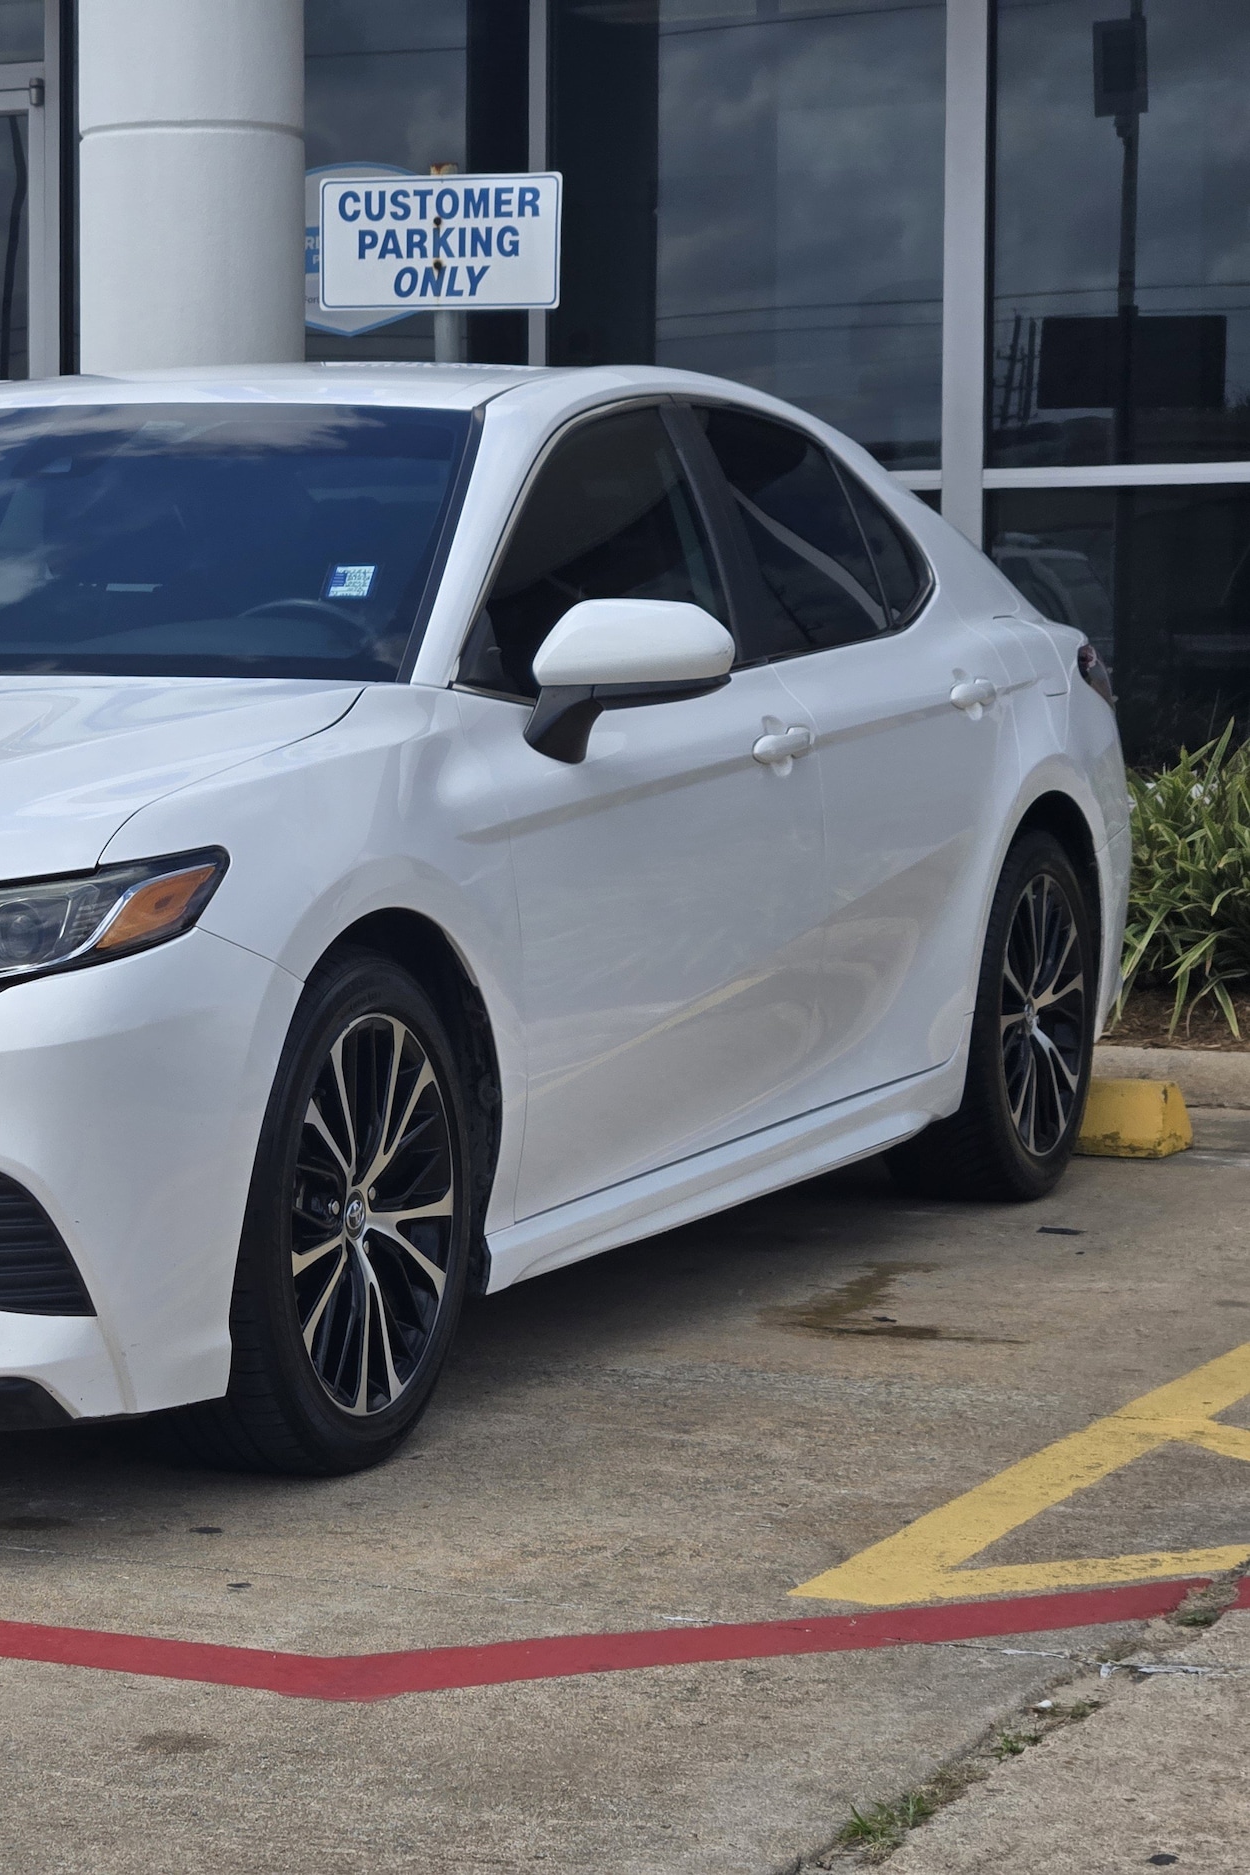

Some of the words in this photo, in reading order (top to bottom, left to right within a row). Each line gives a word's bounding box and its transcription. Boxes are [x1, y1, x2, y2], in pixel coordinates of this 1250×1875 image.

[338, 187, 541, 222] CUSTOMER
[358, 225, 520, 259] PARKING
[393, 265, 491, 298] ONLY
